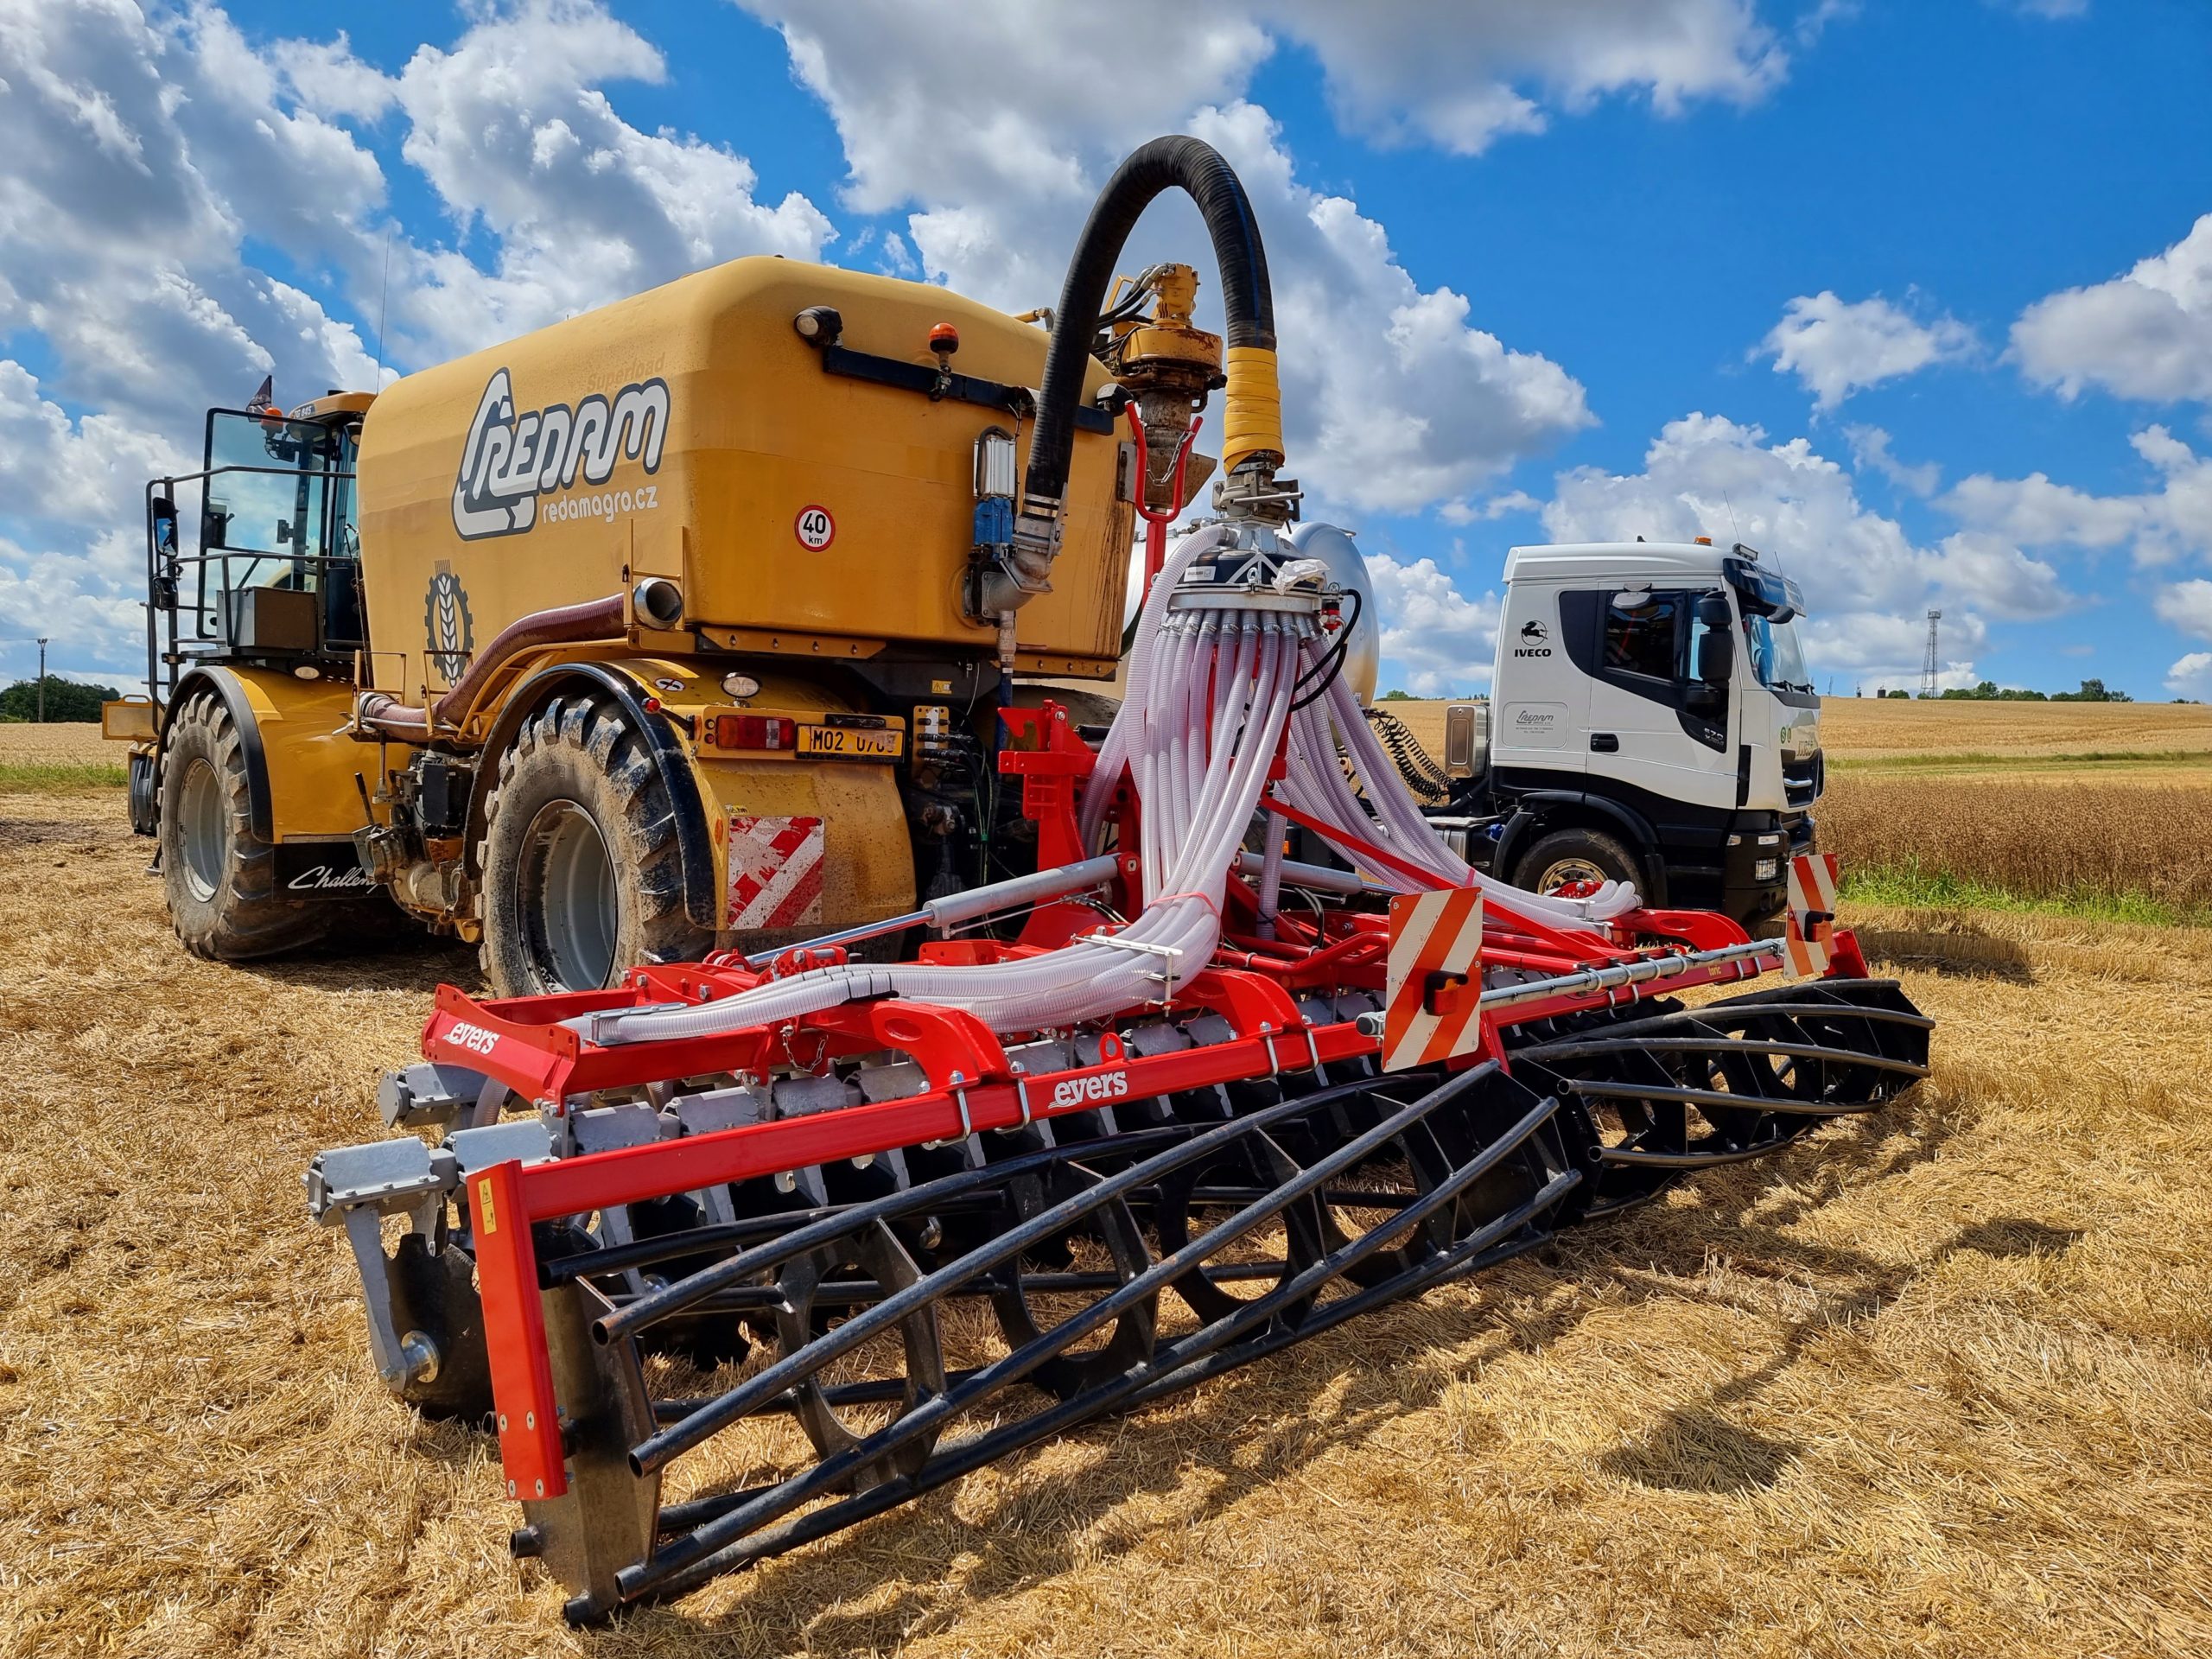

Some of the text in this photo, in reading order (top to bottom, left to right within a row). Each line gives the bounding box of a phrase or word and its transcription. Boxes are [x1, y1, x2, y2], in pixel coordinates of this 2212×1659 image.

[586, 352, 665, 392] Superload
[542, 485, 659, 524] redamagro.cz
[803, 512, 827, 534] 40
[808, 535, 823, 544] km
[1514, 648, 1552, 658] IVECO
[1052, 1071, 1128, 1107] evers
